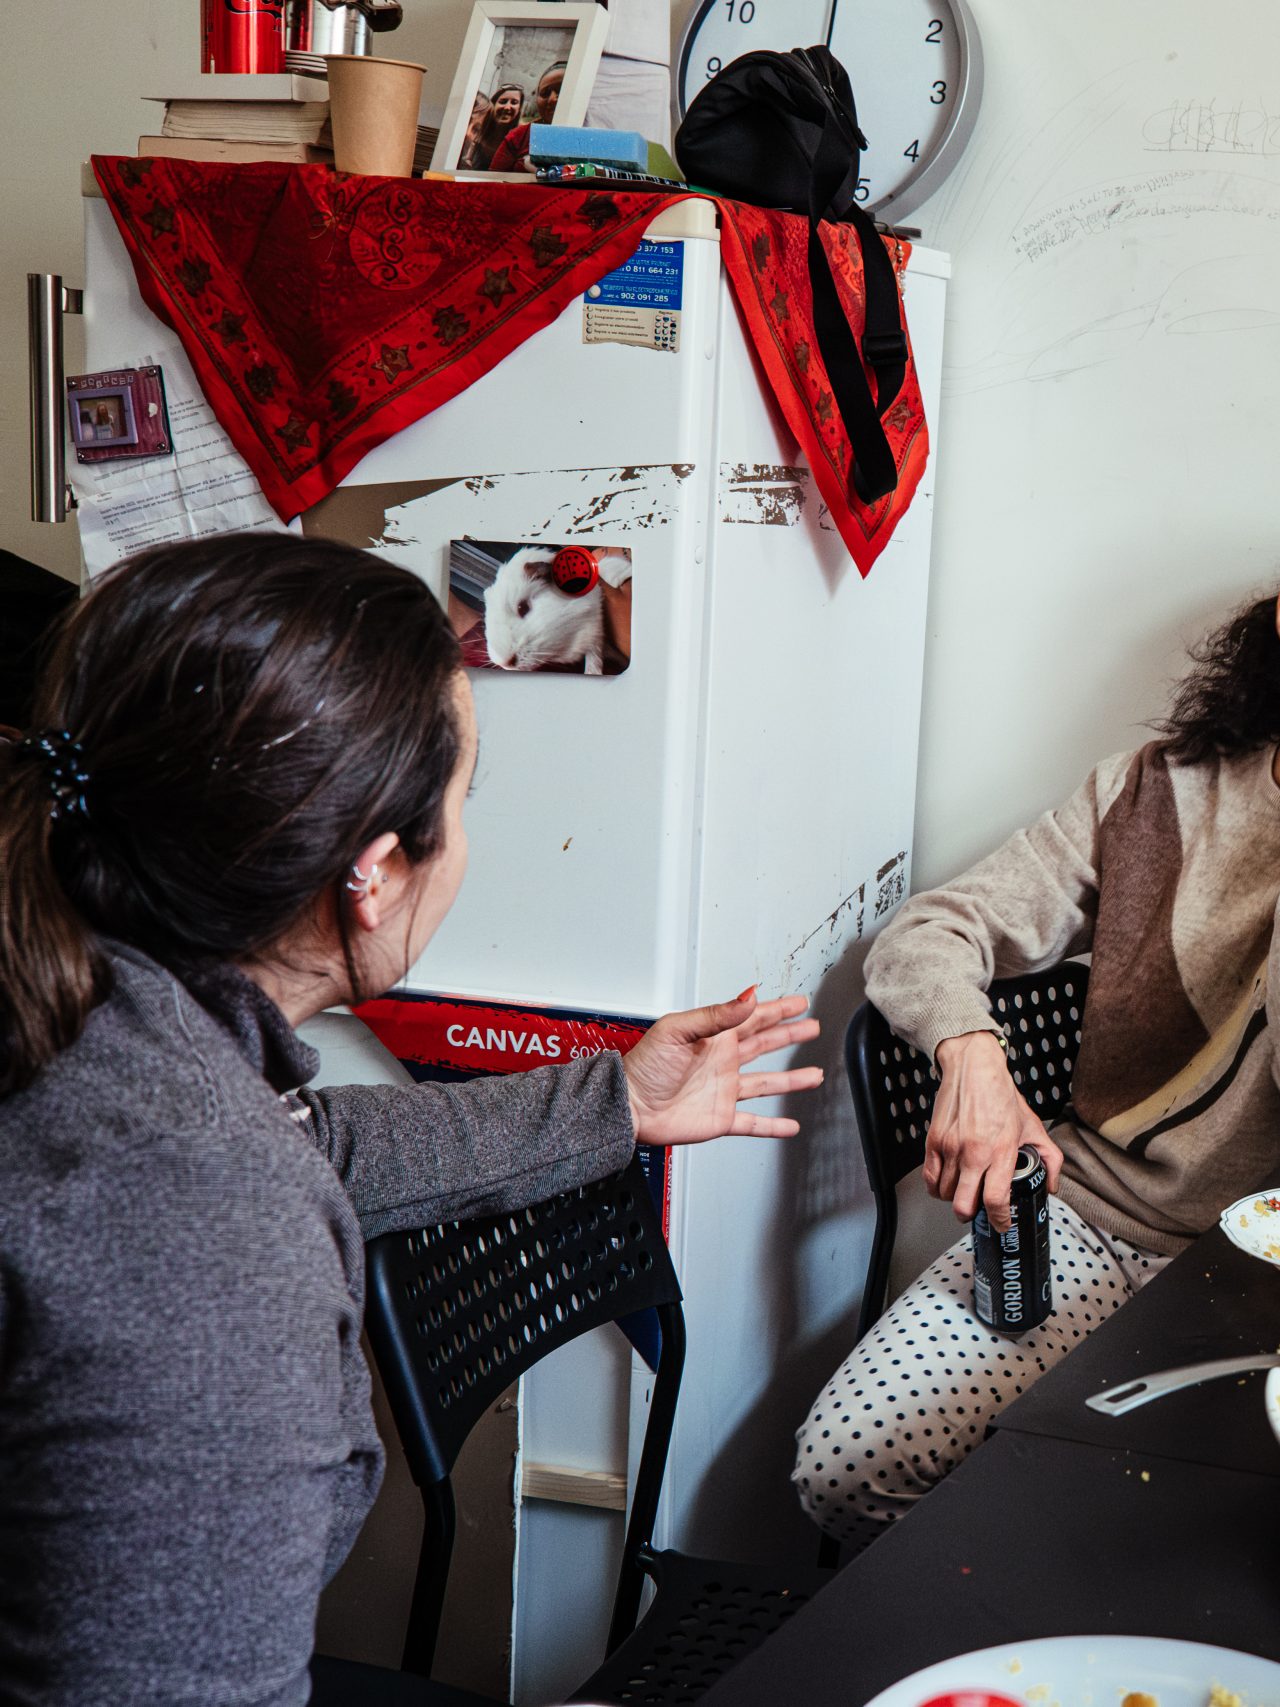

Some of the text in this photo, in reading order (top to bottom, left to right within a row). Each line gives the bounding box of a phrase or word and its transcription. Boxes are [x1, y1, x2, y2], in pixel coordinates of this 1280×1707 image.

[725, 0, 755, 24] 10
[925, 19, 943, 43] 2
[706, 57, 722, 80] 9
[930, 80, 947, 104] 3
[903, 139, 920, 163] 4
[854, 178, 871, 202] 5
[620, 292, 635, 300] 902
[637, 293, 651, 301] 091
[446, 1024, 561, 1058] CANVAS
[1003, 1258, 1023, 1322] GORDON
